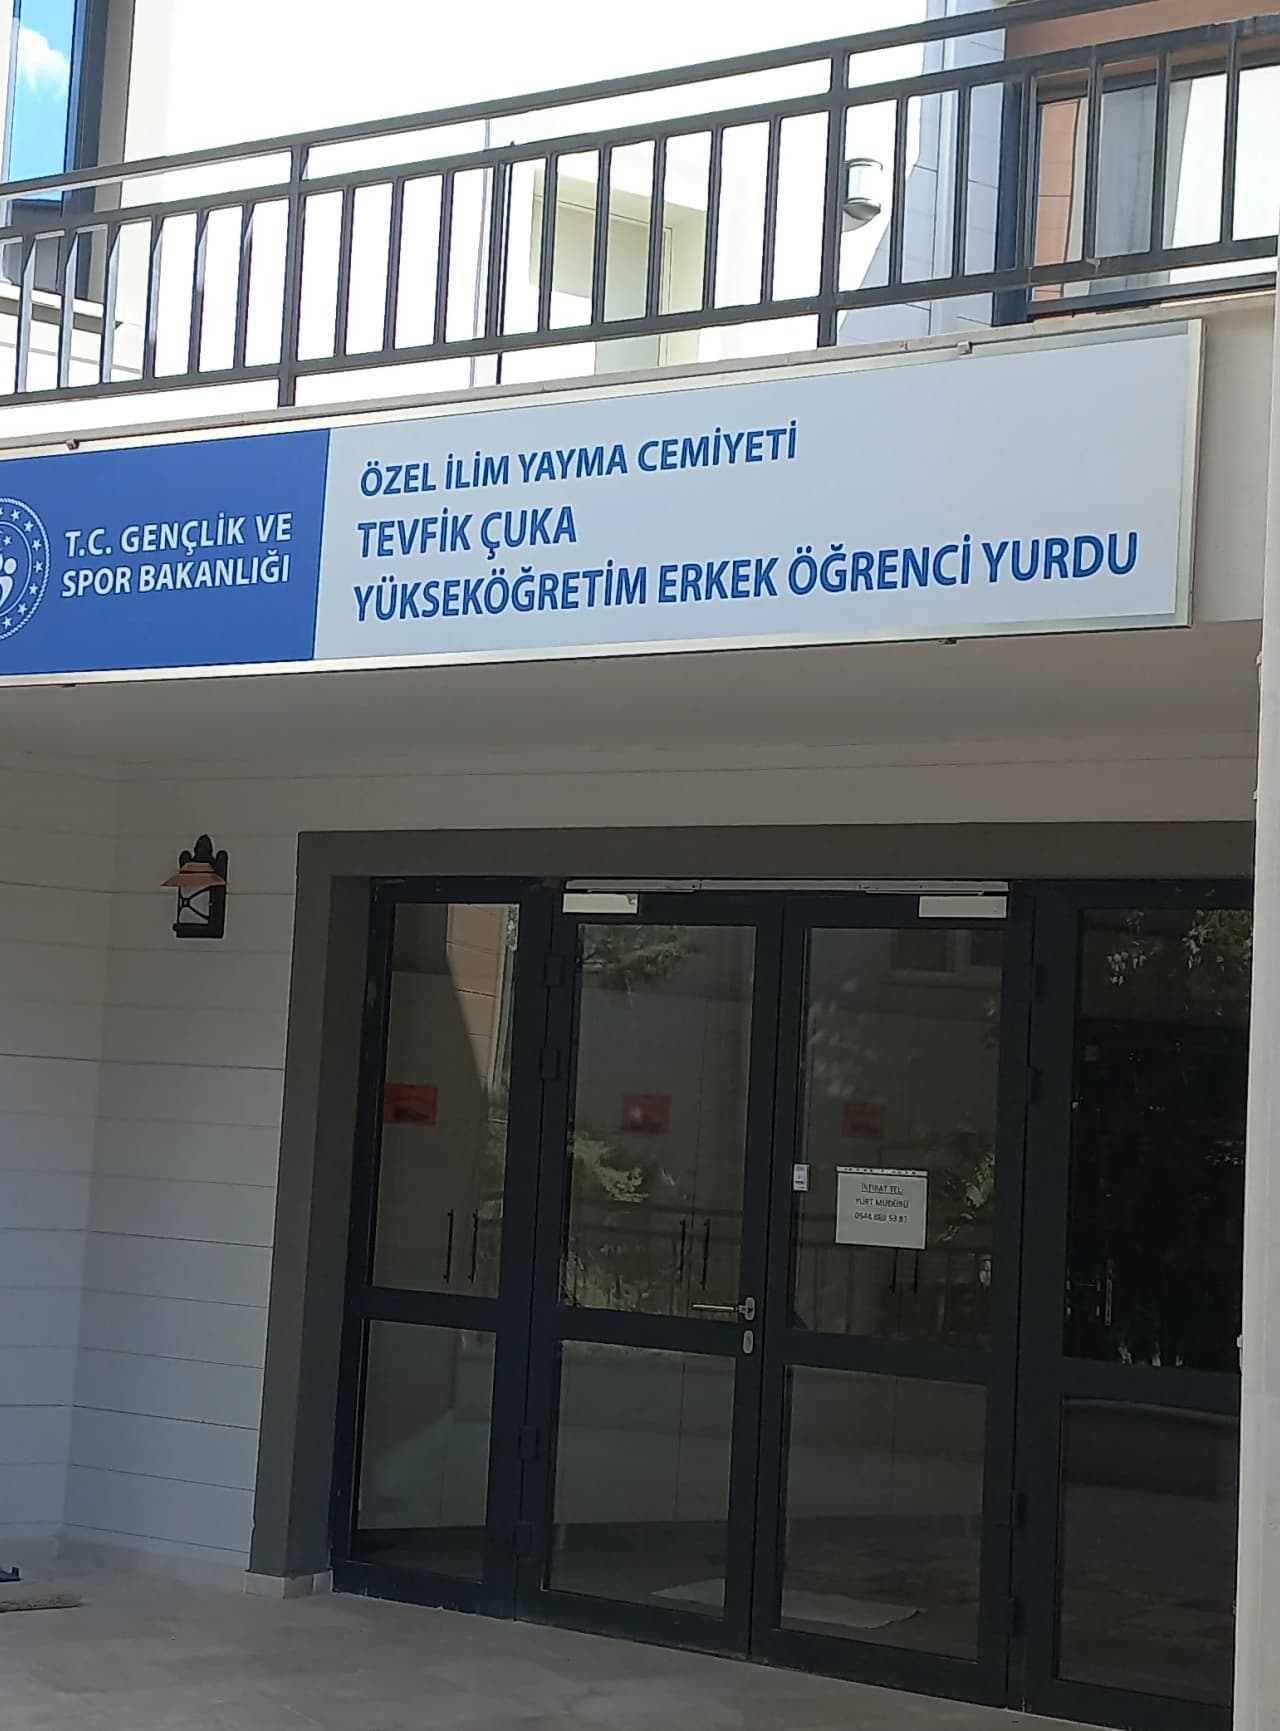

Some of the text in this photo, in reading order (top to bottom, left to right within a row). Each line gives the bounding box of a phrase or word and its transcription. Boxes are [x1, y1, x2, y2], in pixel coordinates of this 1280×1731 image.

[360, 419, 797, 497] ÖZEL İLİM YAYMA CEMİYETİ
[65, 511, 292, 557] T.C. GENÇLİK VE
[357, 505, 577, 561] TEVFİK ÇUKA
[62, 549, 289, 597] SPOR BAKANLIĞI
[353, 531, 1138, 622] YÜKSEKÖĞRETİM ERKEK ÖĞRENCİ YURDU
